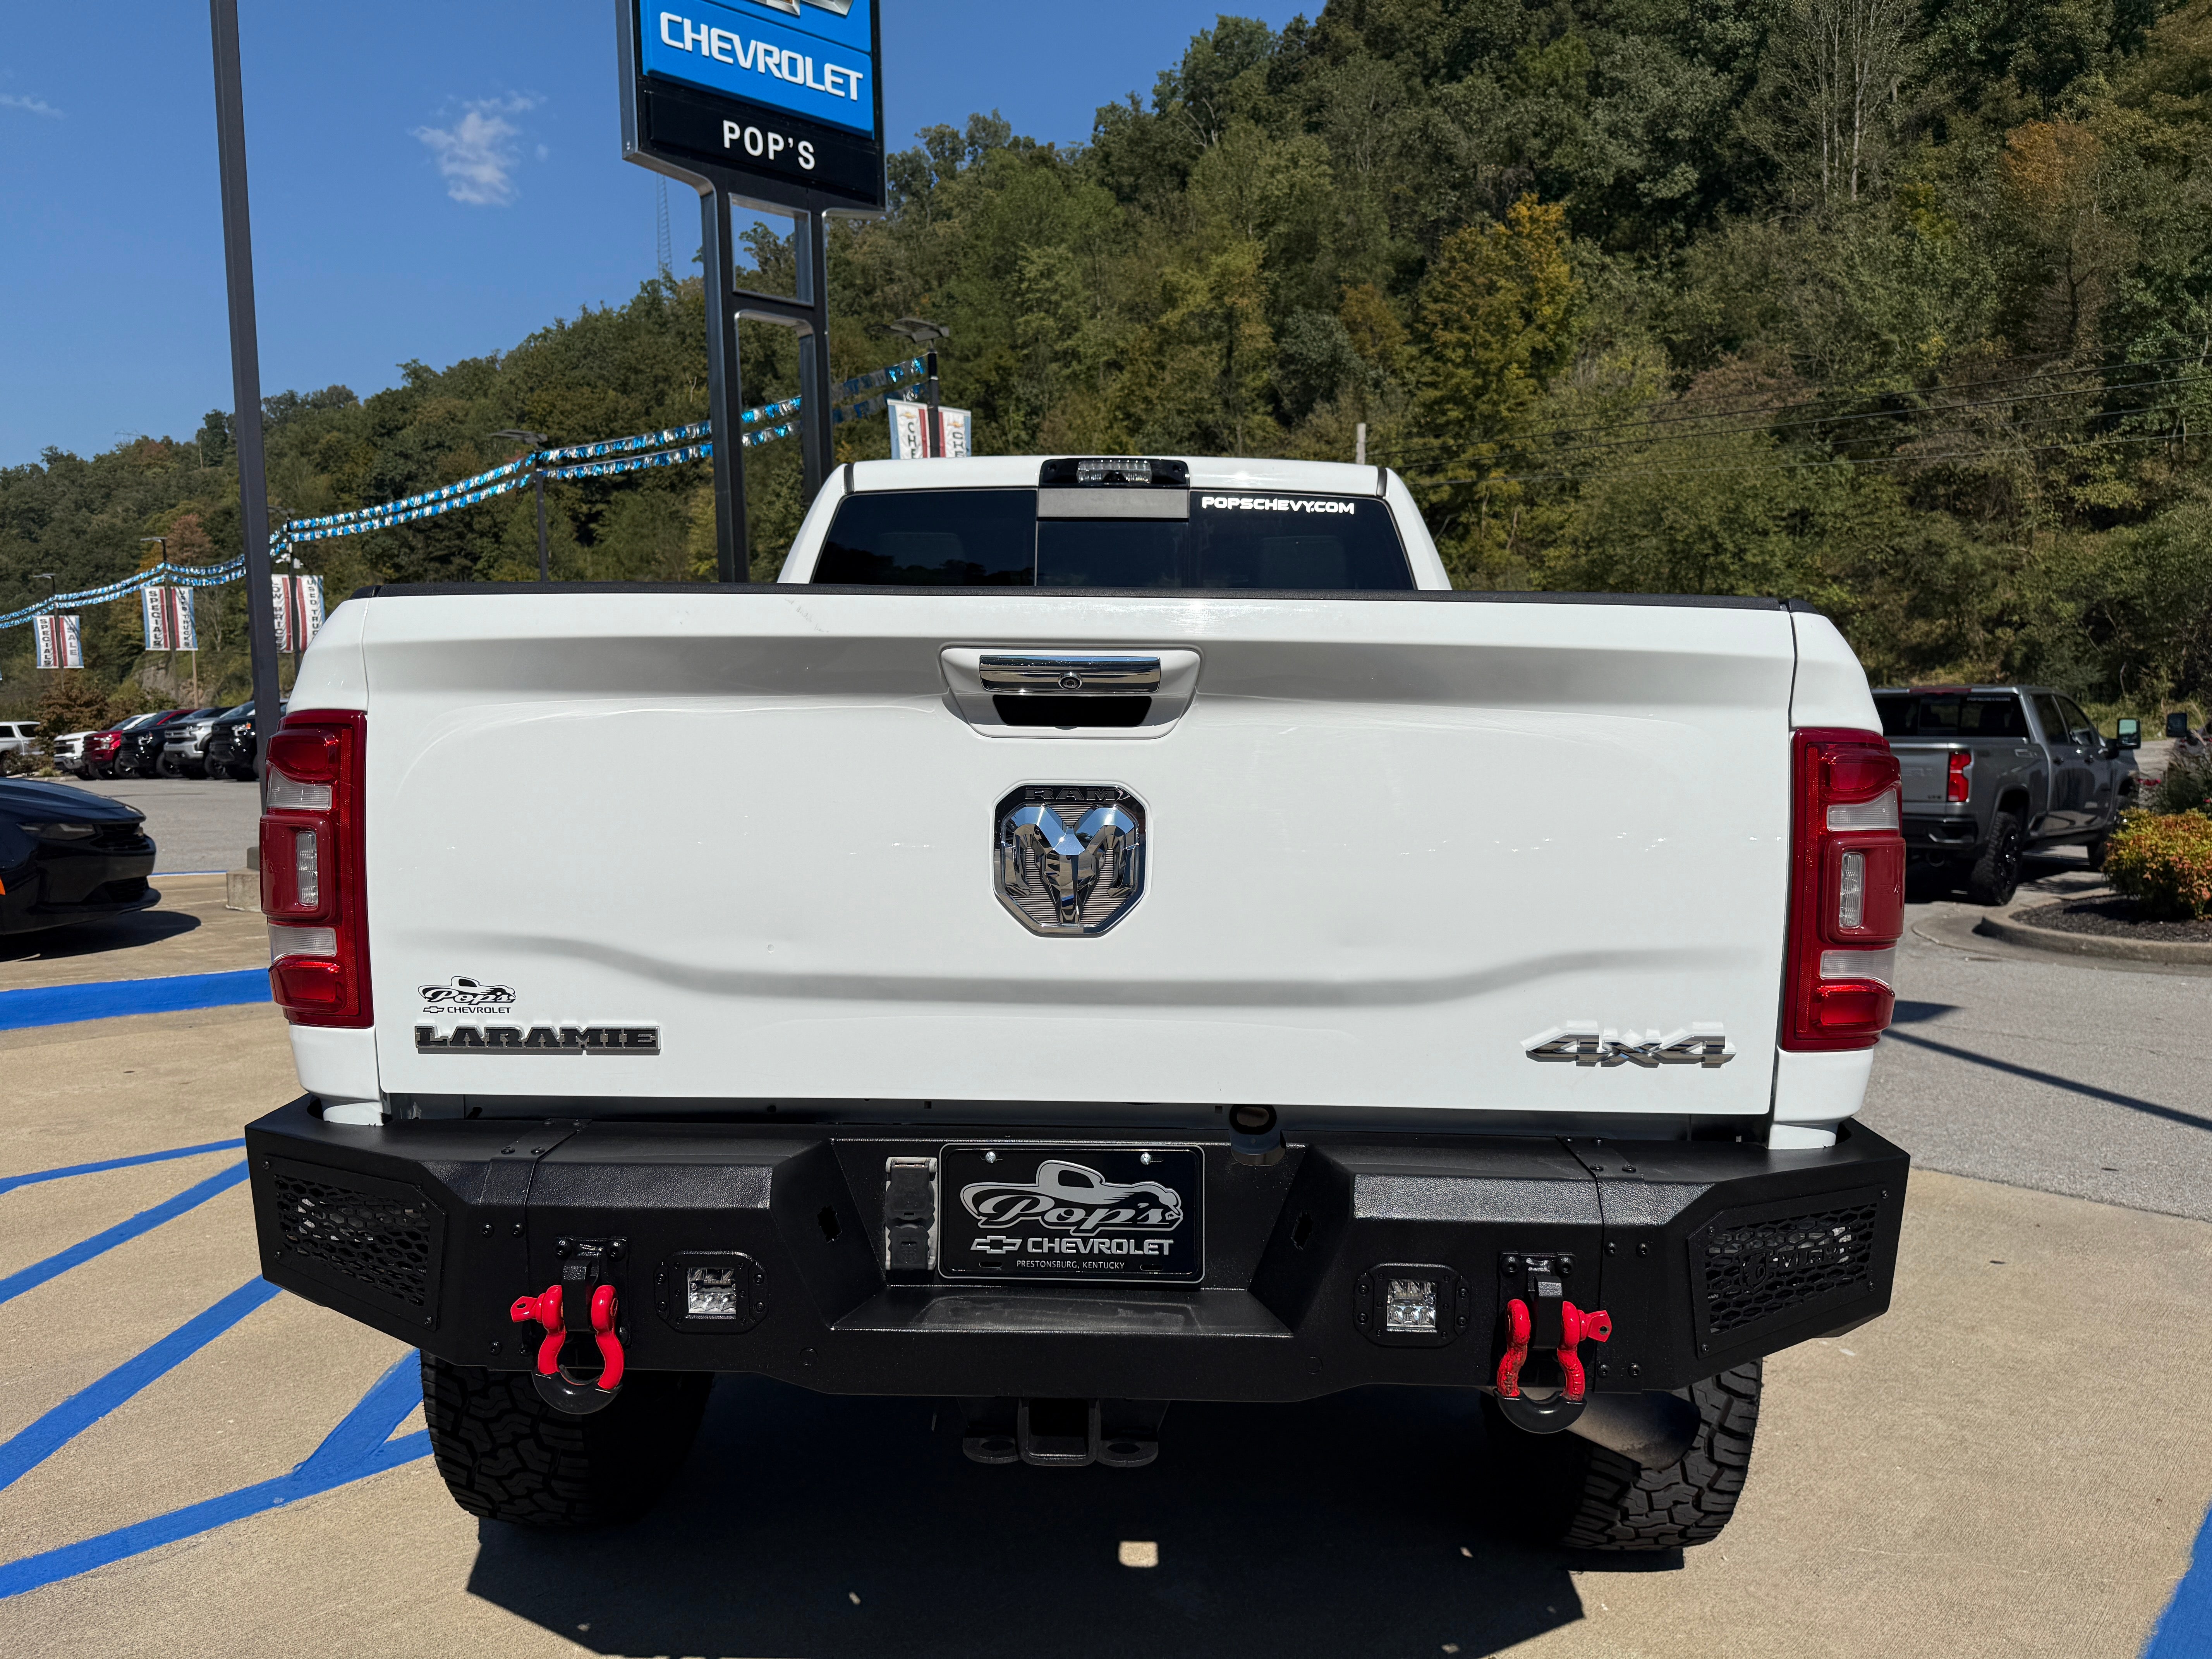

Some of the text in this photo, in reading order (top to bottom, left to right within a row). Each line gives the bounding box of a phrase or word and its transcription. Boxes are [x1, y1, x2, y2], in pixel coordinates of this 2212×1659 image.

[660, 12, 863, 101] CHEVROLET
[723, 120, 815, 170] POP'S
[1202, 497, 1354, 515] POPSCHEVY.COM
[149, 591, 161, 646] SPECIALS
[40, 619, 51, 666] SPECIALS
[67, 627, 77, 655] SALE
[1025, 787, 1116, 800] RAM
[425, 988, 512, 1005] Pop's
[414, 1025, 661, 1051] LARAMIE
[979, 1195, 1170, 1230] Pop's
[1027, 1238, 1174, 1255] CHEVROLET
[1017, 1260, 1125, 1269] PRESTONSBURG, KENTUCKY
